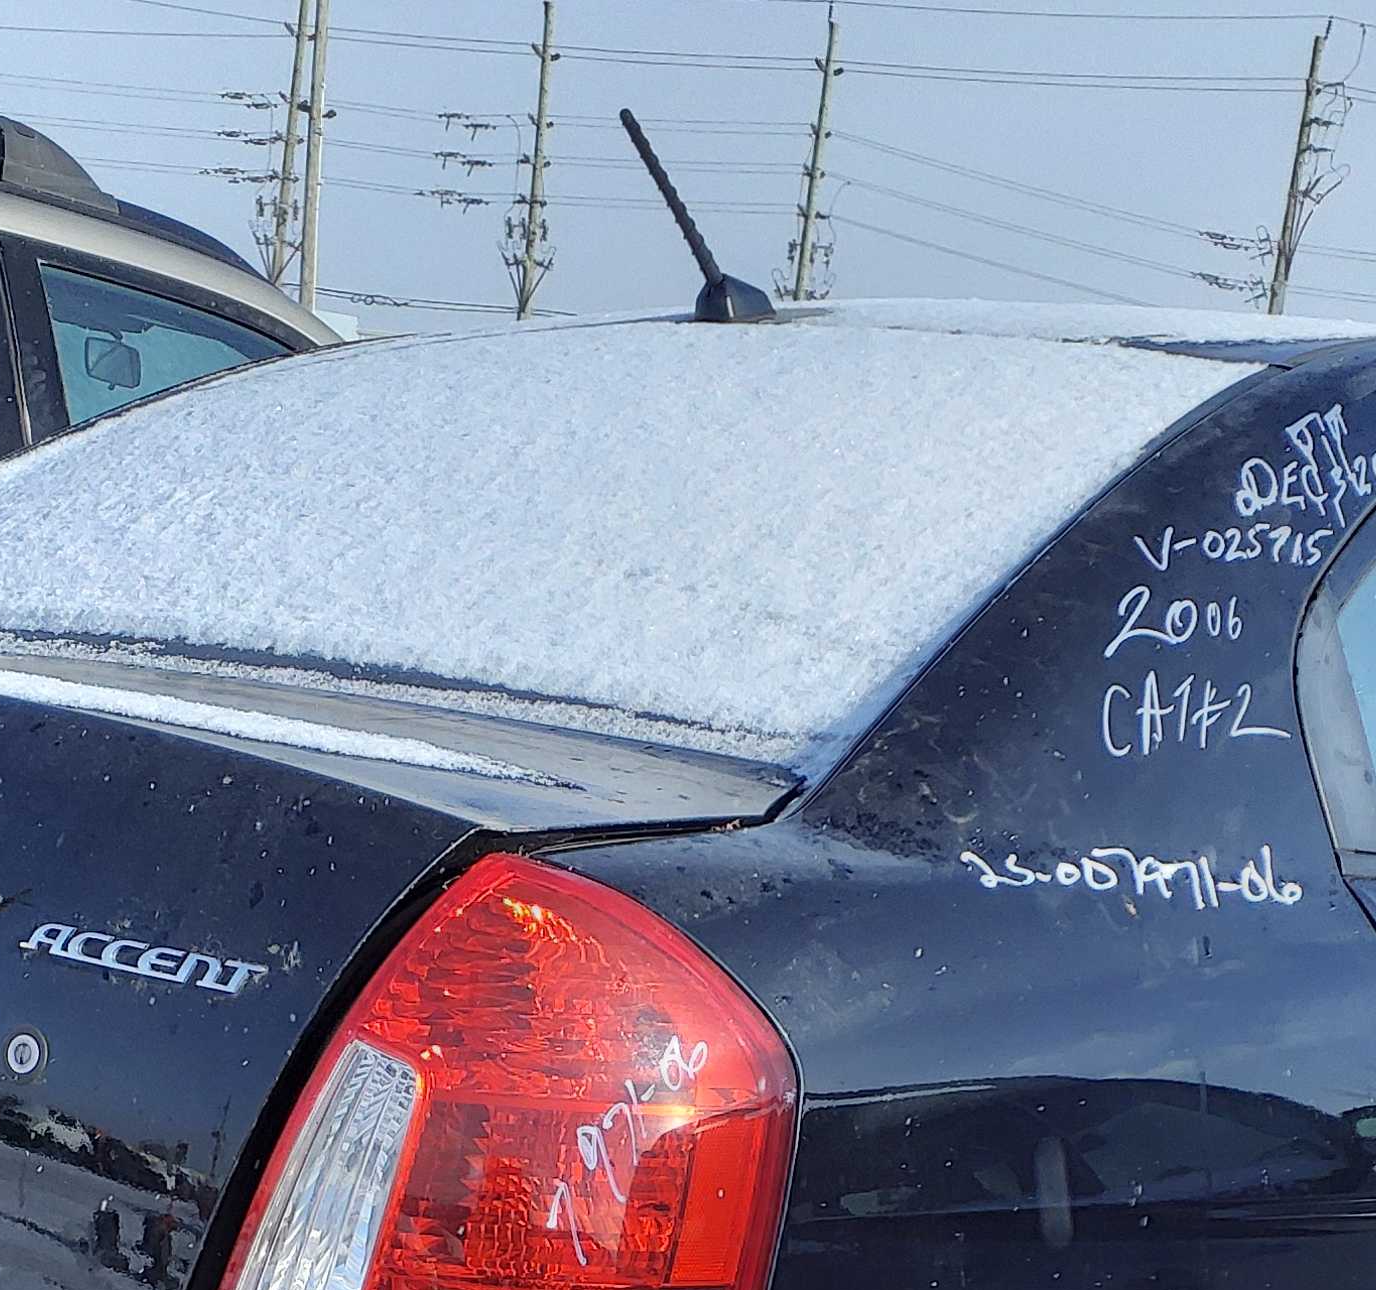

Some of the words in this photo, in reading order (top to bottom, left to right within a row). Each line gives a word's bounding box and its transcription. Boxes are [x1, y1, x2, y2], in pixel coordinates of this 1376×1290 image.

[1103, 585, 1244, 659] 2006
[1102, 669, 1293, 757] CAT#2
[19, 922, 270, 995] ACCENT
